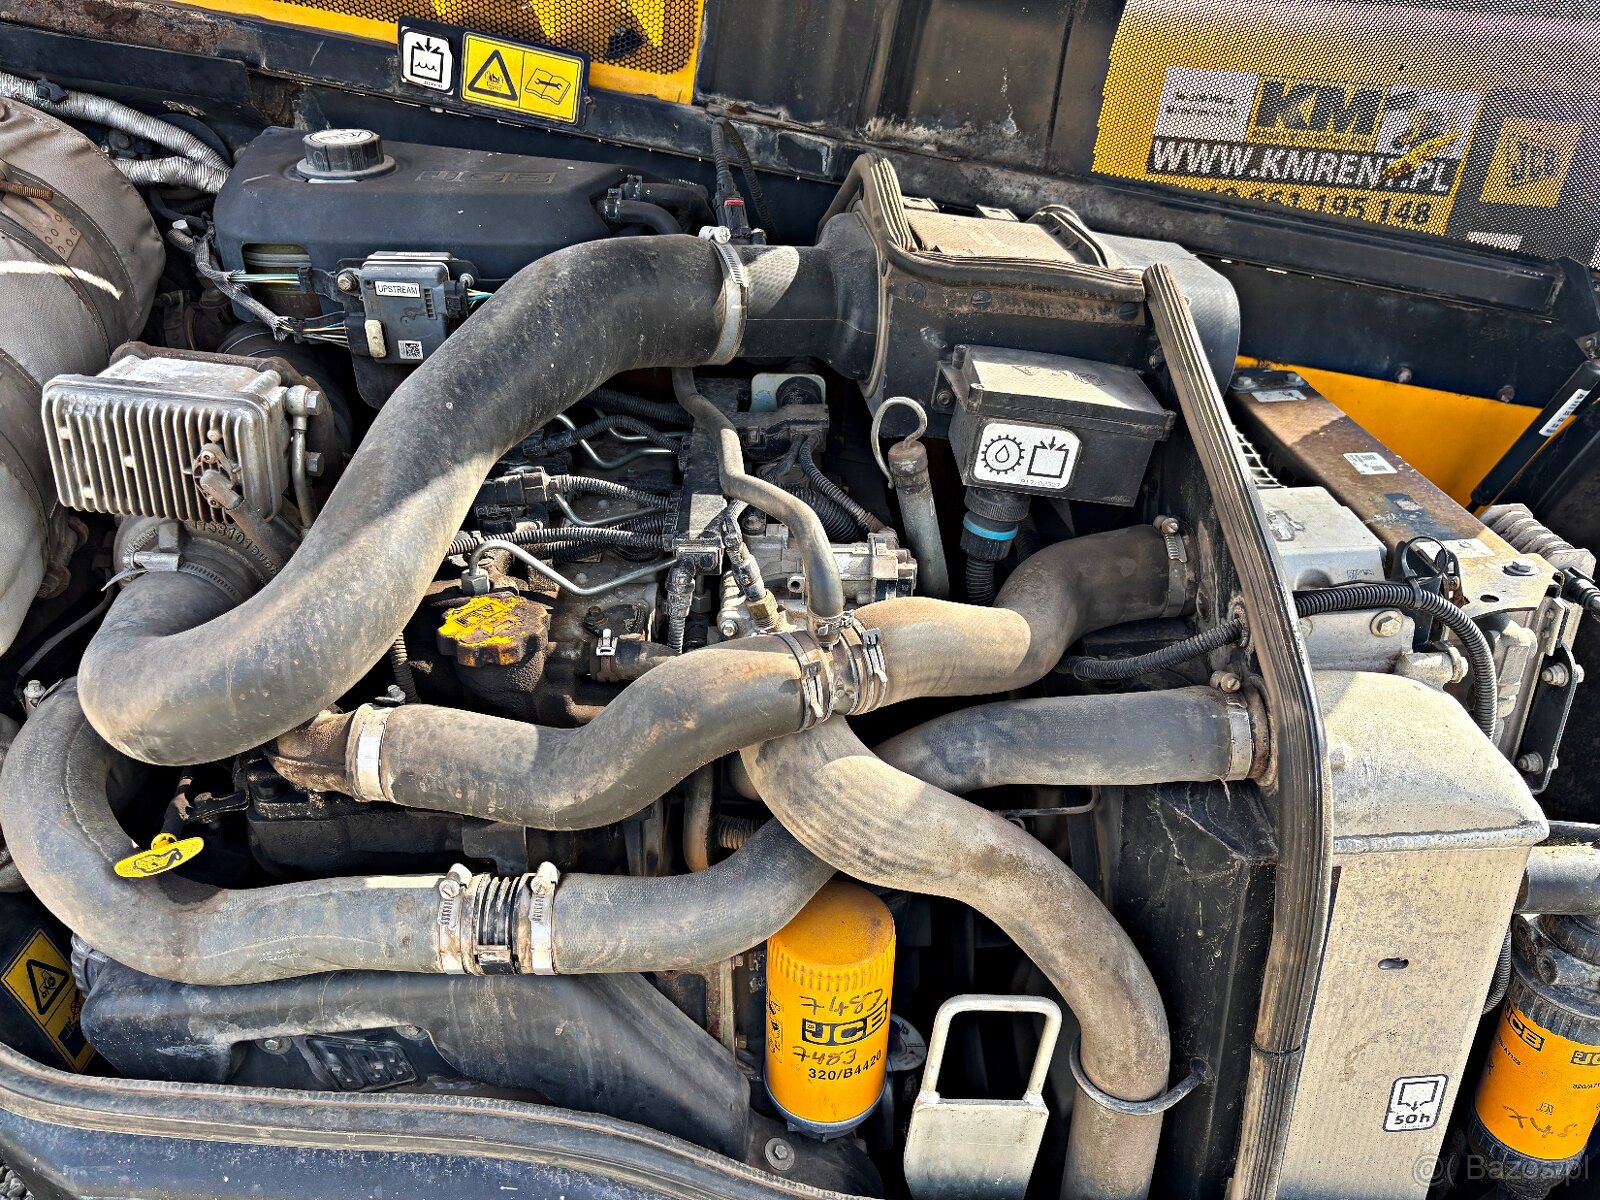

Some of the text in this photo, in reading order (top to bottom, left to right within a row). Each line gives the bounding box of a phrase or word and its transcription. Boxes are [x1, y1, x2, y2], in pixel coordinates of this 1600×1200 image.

[1255, 82, 1382, 134] KM
[1377, 198, 1432, 225] 148
[376, 284, 419, 295] UPSTREAM
[802, 1000, 888, 1046] JCB
[808, 1050, 882, 1081] 320/B4420
